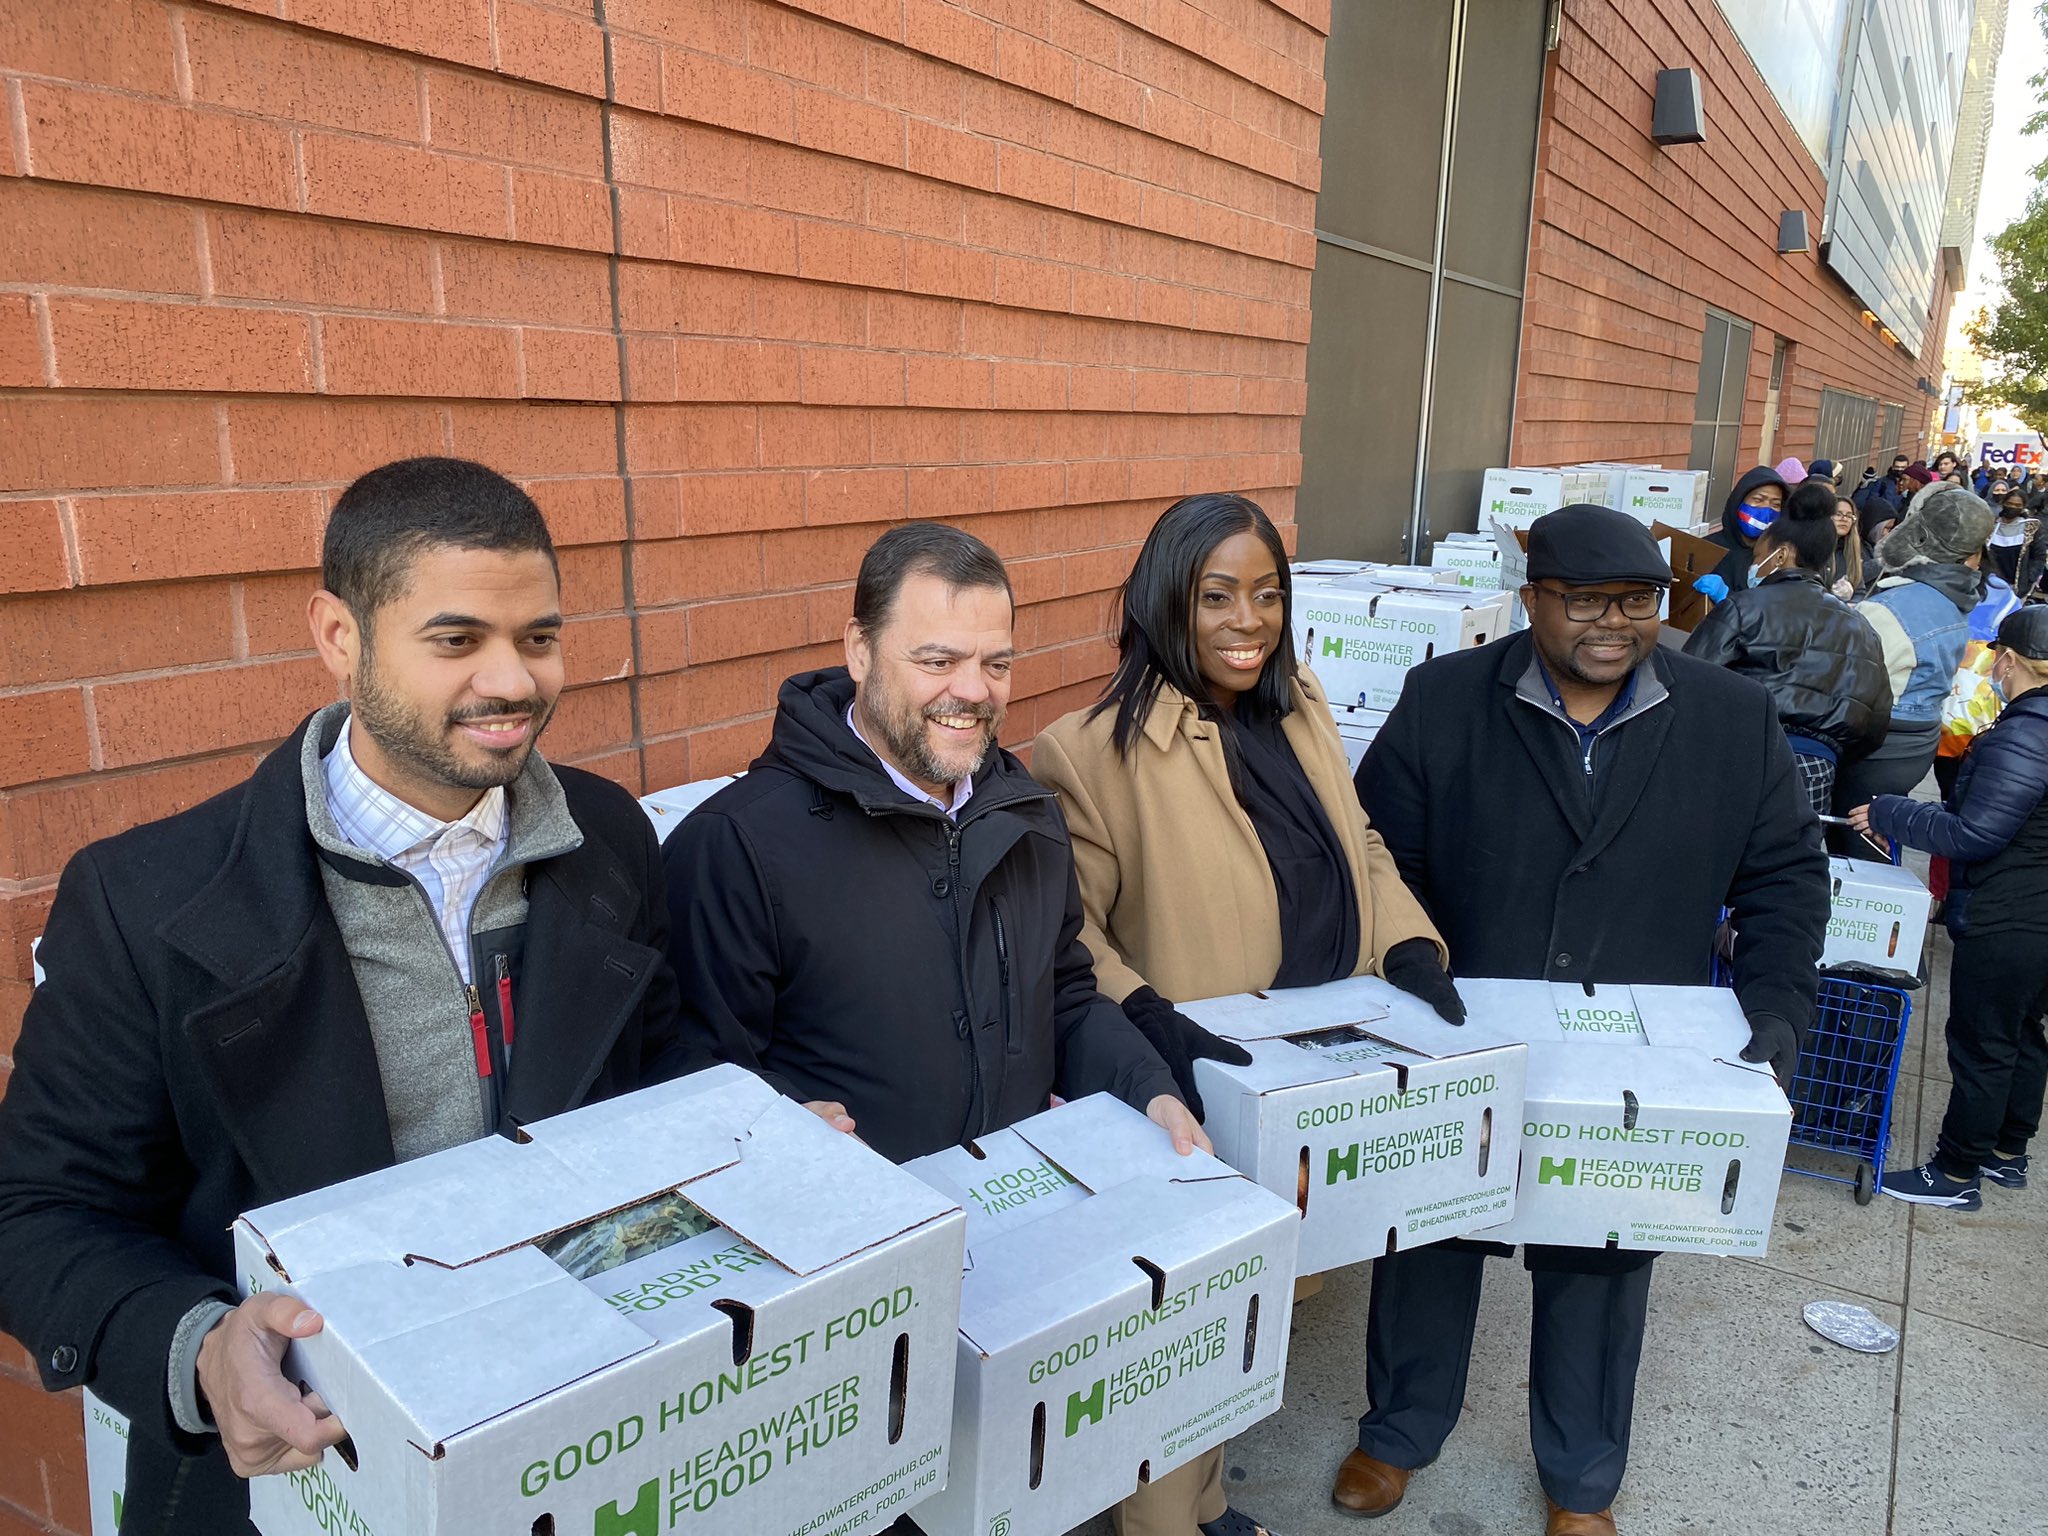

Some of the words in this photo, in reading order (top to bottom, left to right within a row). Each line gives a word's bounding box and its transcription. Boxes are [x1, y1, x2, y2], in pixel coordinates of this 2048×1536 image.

[1980, 442, 2043, 464] FedEx
[1504, 500, 1548, 510] HEADWATER
[1504, 507, 1527, 515] FOOD
[1447, 558, 1472, 567] GOOD
[1475, 560, 1502, 569] HONE
[1306, 609, 1341, 624] GOOD
[1344, 614, 1397, 631] HONEST
[1400, 620, 1439, 636] FOOD.
[1344, 648, 1380, 662] FOOD
[1383, 653, 1412, 667] HUB
[1345, 638, 1414, 655] HEADWATER
[1865, 900, 1906, 916] FOOD.
[1828, 917, 1878, 932] DWATER
[1846, 929, 1877, 942] HUB
[1560, 1021, 1639, 1034] HEADWA
[1577, 1008, 1636, 1023] FOOD
[1296, 1102, 1353, 1130] GOOD
[1360, 1085, 1440, 1118] HONEST
[1445, 1074, 1499, 1100] FOOD.
[1363, 1121, 1464, 1156] HEADWATER
[1523, 1122, 1571, 1139] OOD
[1578, 1125, 1675, 1144] HONEST
[1681, 1130, 1750, 1149] FOOD.
[1362, 1149, 1415, 1177] FOOD
[1422, 1138, 1463, 1163] HUB
[1581, 1158, 1703, 1176] HEADWATER
[983, 1161, 1054, 1195] FOOD
[1579, 1172, 1642, 1189] FOOD
[1650, 1176, 1701, 1192] HUB
[1405, 1185, 1511, 1217] WWW.HEADWATERFOODHUB.COM
[1630, 1222, 1763, 1236] WWW.HEADWATERFOODHUB.COM
[1028, 1335, 1098, 1385] GOOD
[1106, 1283, 1201, 1348] HONEST
[1206, 1254, 1268, 1299] FOOD.
[1110, 1316, 1227, 1391] HEADWATER
[1109, 1364, 1171, 1415] FOOD
[1179, 1336, 1226, 1377] HUB
[520, 1415, 645, 1497] GOOD
[659, 1330, 815, 1433] HONEST
[824, 1285, 920, 1352] FOOD.
[93, 1408, 111, 1428] 3/4
[1160, 1371, 1280, 1442] WWW.HEADWATERFOODHUB.COM
[669, 1375, 860, 1494] HEADWATER
[669, 1449, 772, 1529] FOOD
[785, 1403, 860, 1465] HUB
[789, 1445, 942, 1536] HEADWATERFOODHUB.COM
